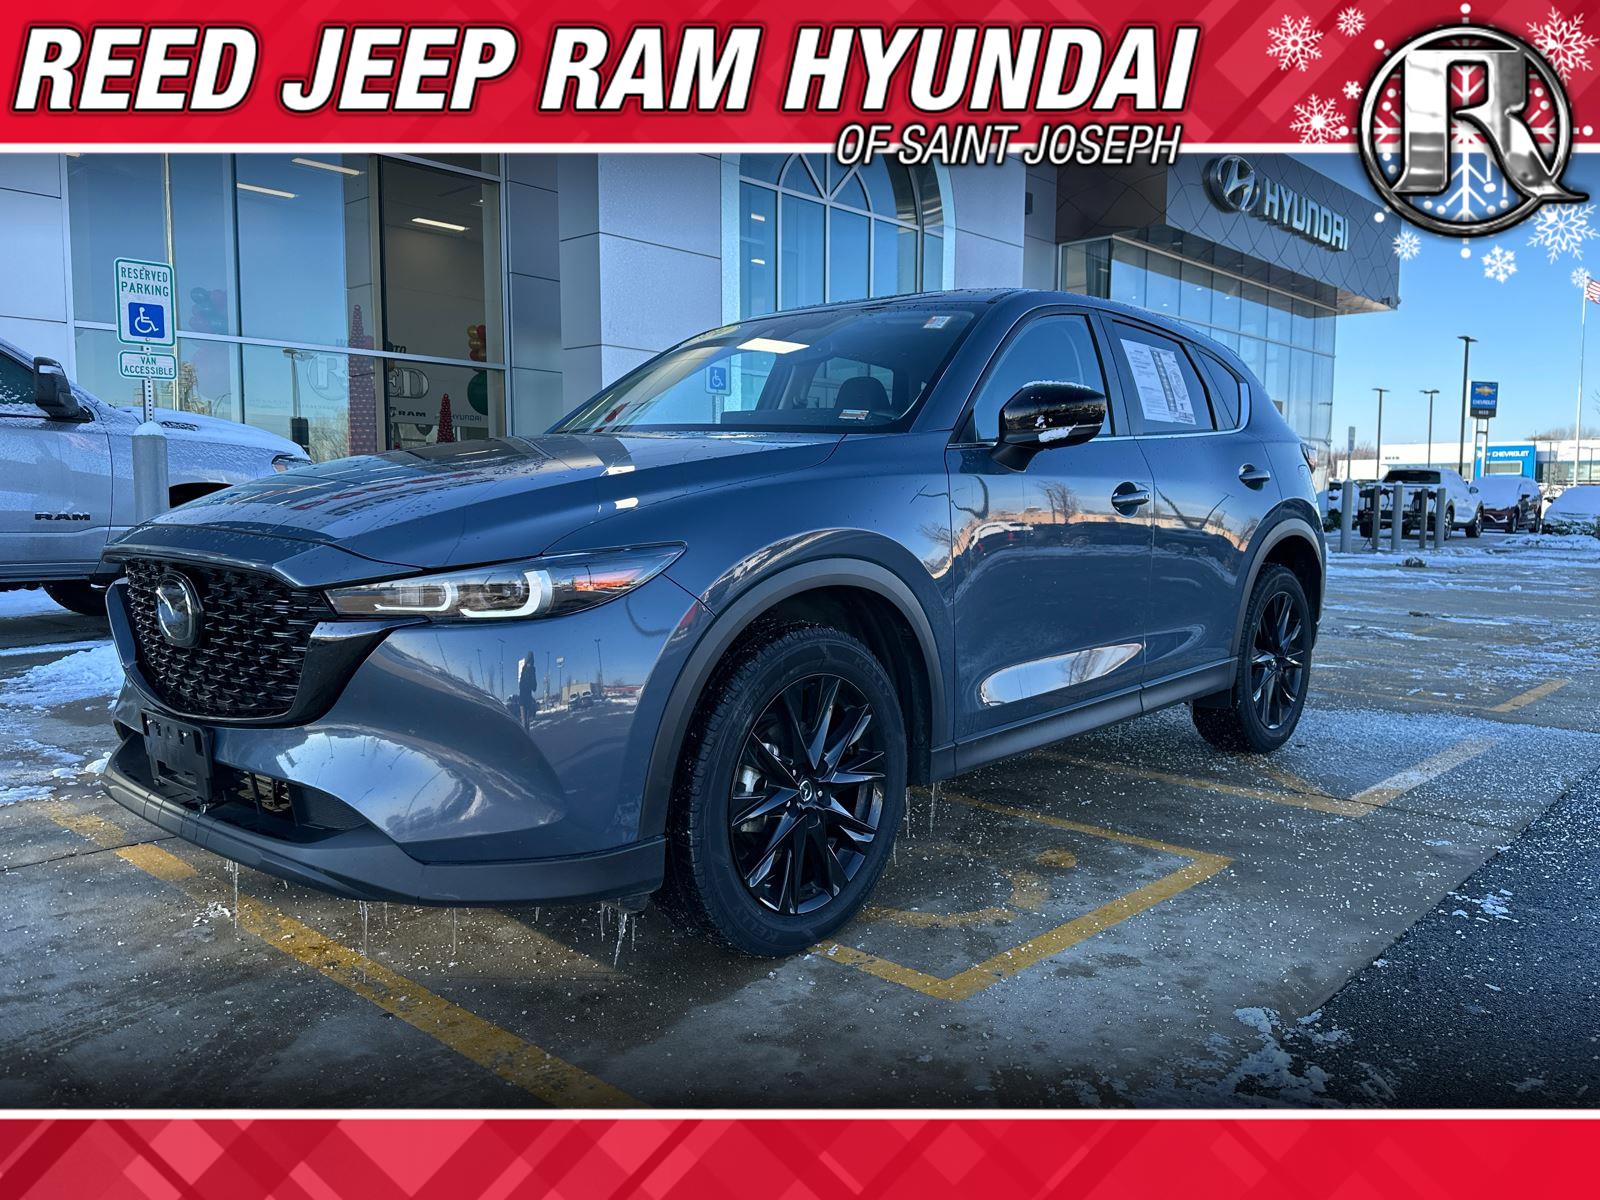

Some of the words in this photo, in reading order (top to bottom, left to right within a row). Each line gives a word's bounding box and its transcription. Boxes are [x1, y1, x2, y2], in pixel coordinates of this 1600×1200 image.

[1263, 176, 1349, 251] HYUNDAI
[121, 266, 168, 283] RESERVED
[121, 281, 169, 297] PARKING
[140, 355, 157, 366] VAN
[123, 365, 173, 376] ACCESSIBLE
[398, 410, 426, 418] RAM
[34, 511, 91, 521] RAM
